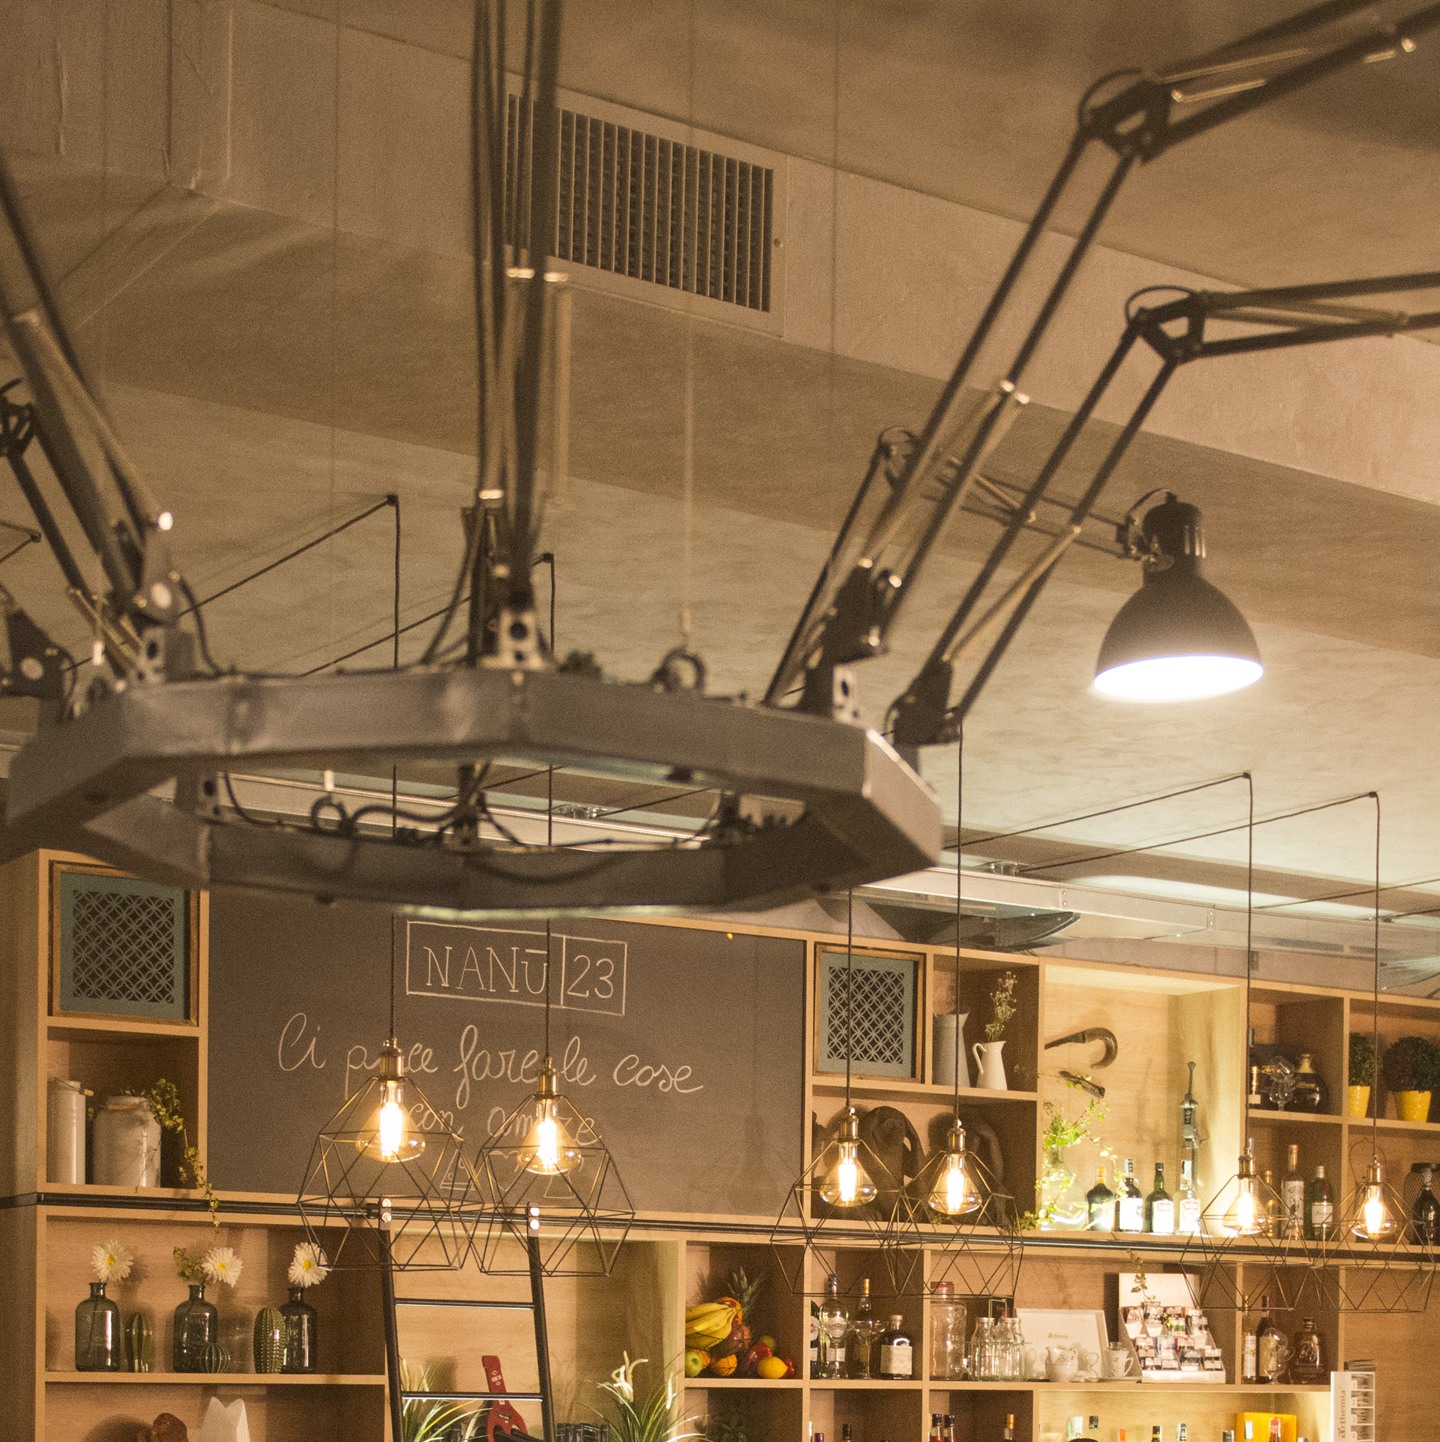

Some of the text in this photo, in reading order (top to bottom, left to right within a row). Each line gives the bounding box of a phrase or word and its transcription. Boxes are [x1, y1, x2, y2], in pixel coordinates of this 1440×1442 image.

[566, 954, 614, 999] 23
[277, 1012, 704, 1110] Ci pce fare le cose
